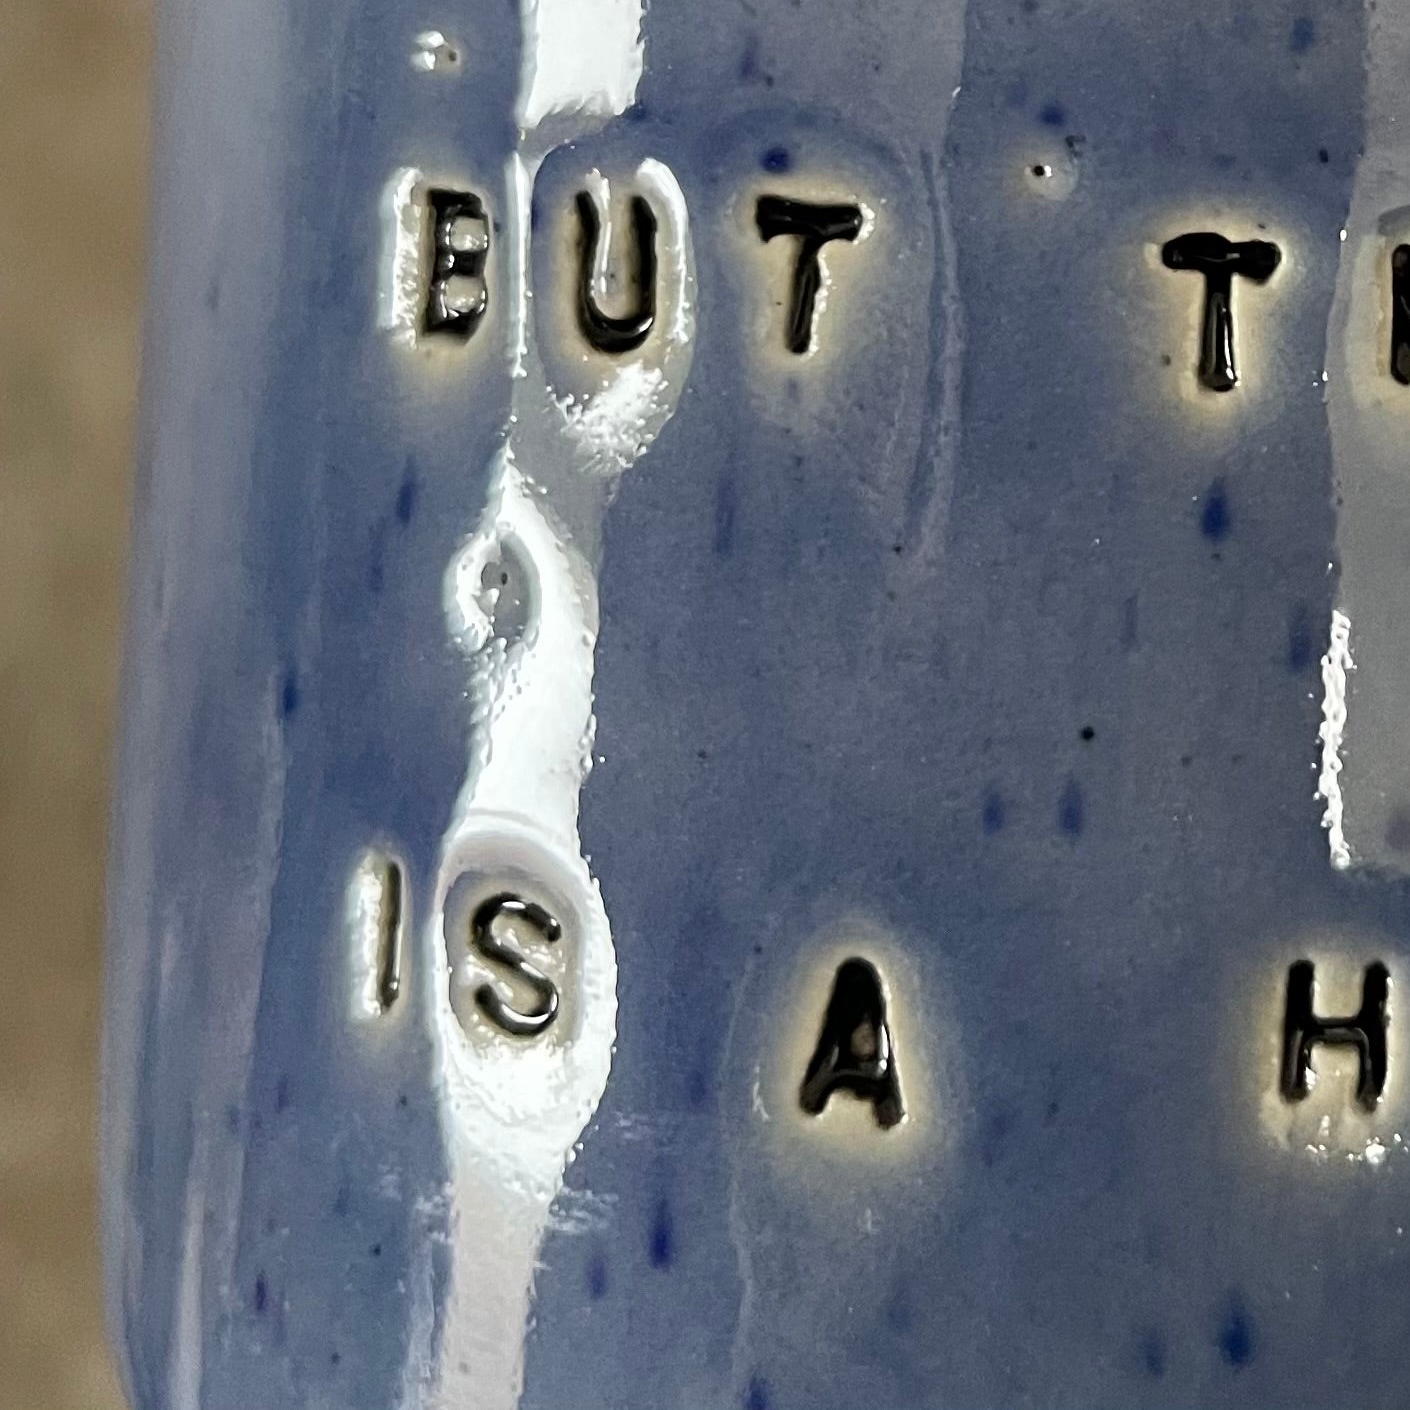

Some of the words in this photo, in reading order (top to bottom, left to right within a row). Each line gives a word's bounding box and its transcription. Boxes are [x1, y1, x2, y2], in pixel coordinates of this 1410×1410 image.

[415, 186, 863, 355] BUT
[370, 857, 562, 1038] IS
[800, 955, 907, 1131] A
